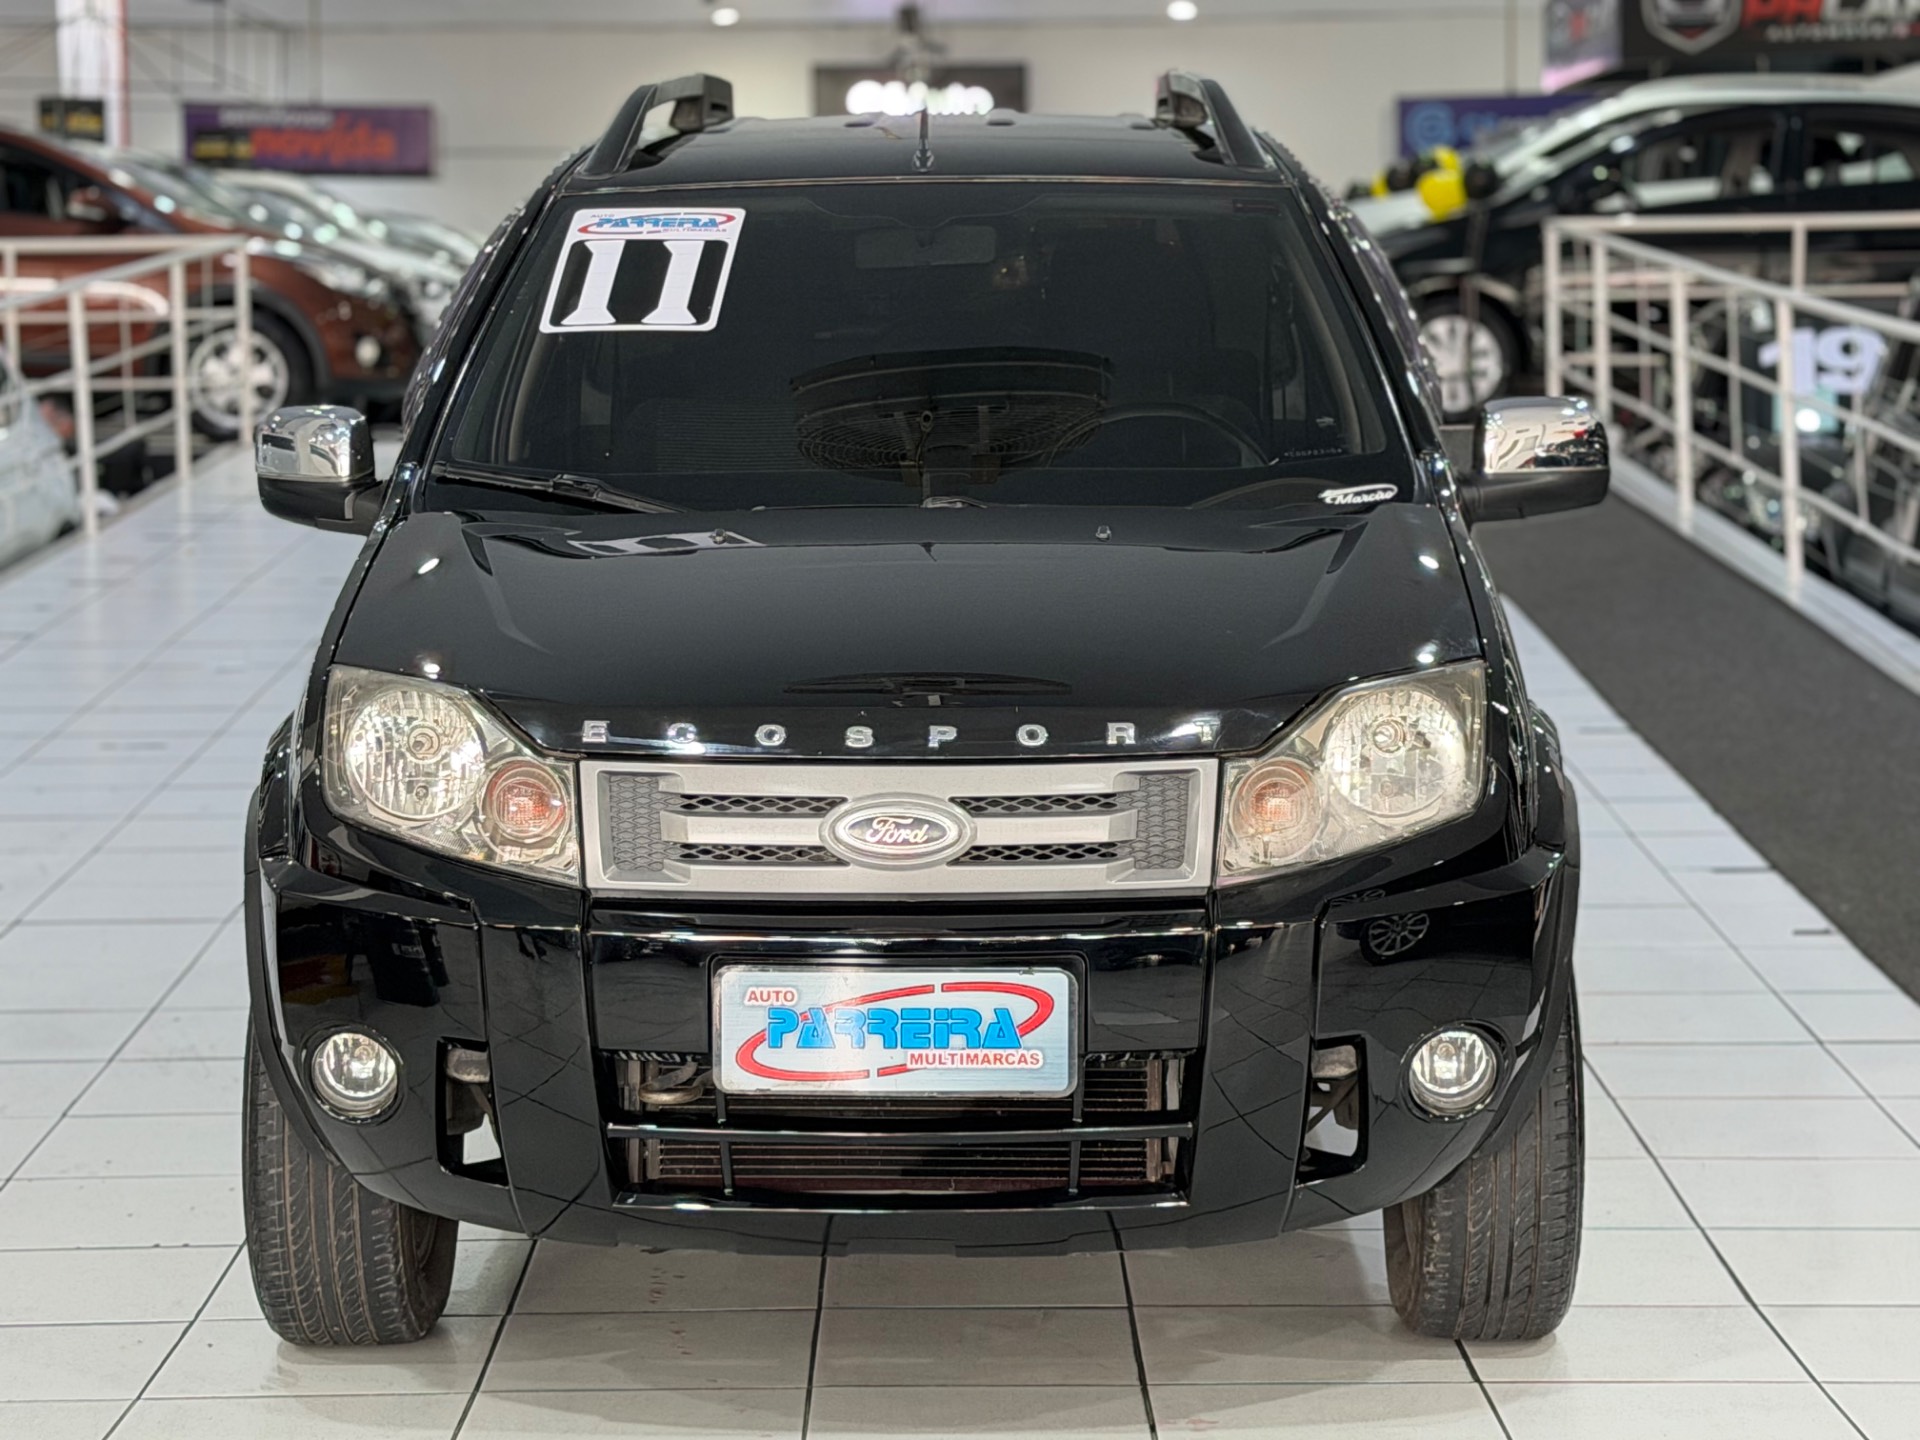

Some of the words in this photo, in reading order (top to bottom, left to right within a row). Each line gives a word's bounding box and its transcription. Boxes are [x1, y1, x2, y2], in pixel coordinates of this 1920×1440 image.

[560, 239, 706, 326] 11
[1758, 325, 1888, 396] 19
[865, 816, 929, 844] Ford
[747, 988, 796, 1004] AUTO
[767, 1007, 1023, 1050] PARREIRA
[908, 1052, 1041, 1067] MULTIMARCAS
